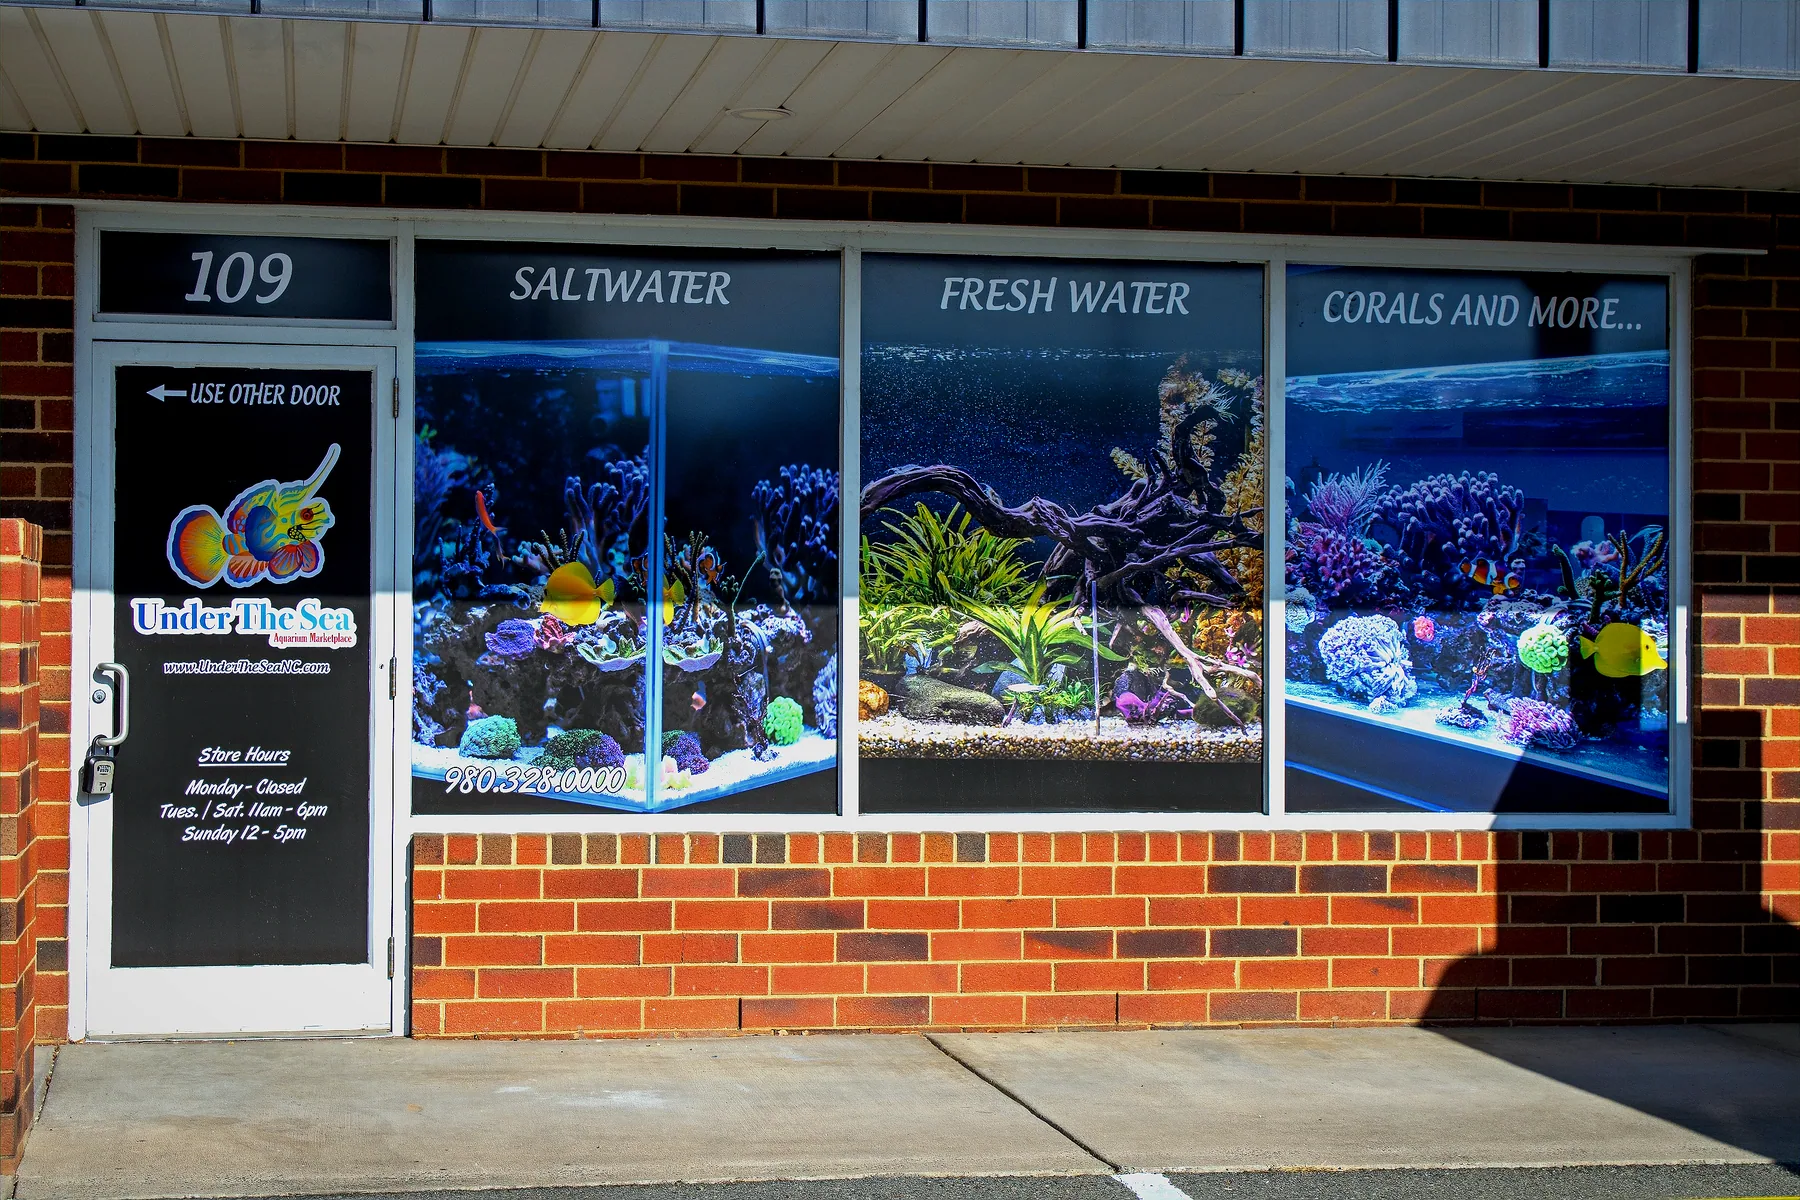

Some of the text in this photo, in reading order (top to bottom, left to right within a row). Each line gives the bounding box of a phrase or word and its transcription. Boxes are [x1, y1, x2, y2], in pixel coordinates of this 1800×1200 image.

[184, 251, 293, 304] 109
[509, 266, 731, 305] SALTWATER
[940, 277, 1190, 315] FRESH WATER
[1323, 290, 1642, 330] CORALS AND MORE...
[190, 382, 341, 406] USE OTHER DOOR
[136, 602, 350, 631] Under The Sea
[273, 632, 353, 645] Aquarium Marketplace
[163, 660, 331, 675] www.UnderTheSeaNC.com
[198, 746, 291, 763] Store Hours
[185, 778, 244, 799] Monday
[256, 777, 307, 795] Closed
[444, 765, 627, 794] 980.328.0000
[160, 804, 199, 819] Tues.
[213, 803, 244, 818] Sat.
[248, 802, 282, 818] 11am
[296, 802, 328, 820] 6pm
[181, 824, 238, 844] Sunday
[240, 825, 258, 840] 12
[273, 824, 307, 843] 5pm
